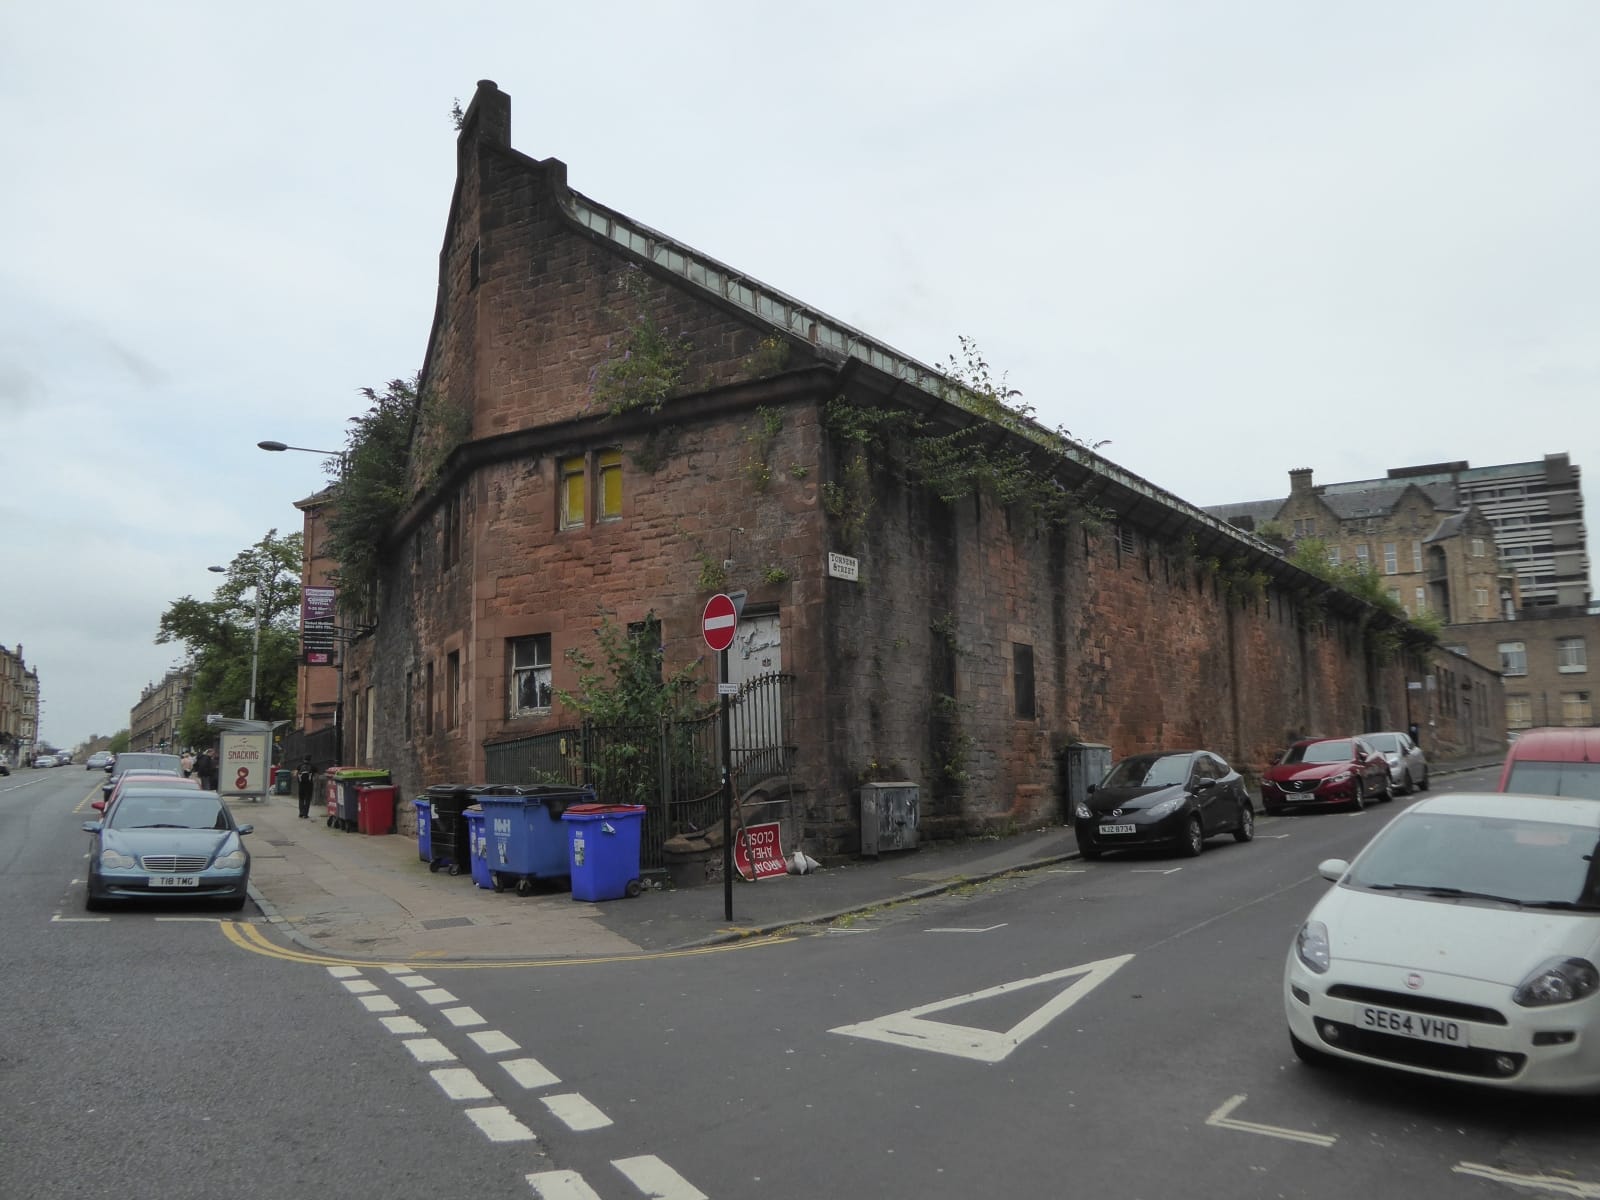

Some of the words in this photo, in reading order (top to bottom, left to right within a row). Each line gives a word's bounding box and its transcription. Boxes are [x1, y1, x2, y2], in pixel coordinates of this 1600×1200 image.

[833, 563, 855, 576] STREET
[227, 751, 259, 760] SNACKING
[176, 877, 193, 886] TMG
[1364, 1008, 1414, 1034] SE64
[1420, 1017, 1459, 1041] VHO
